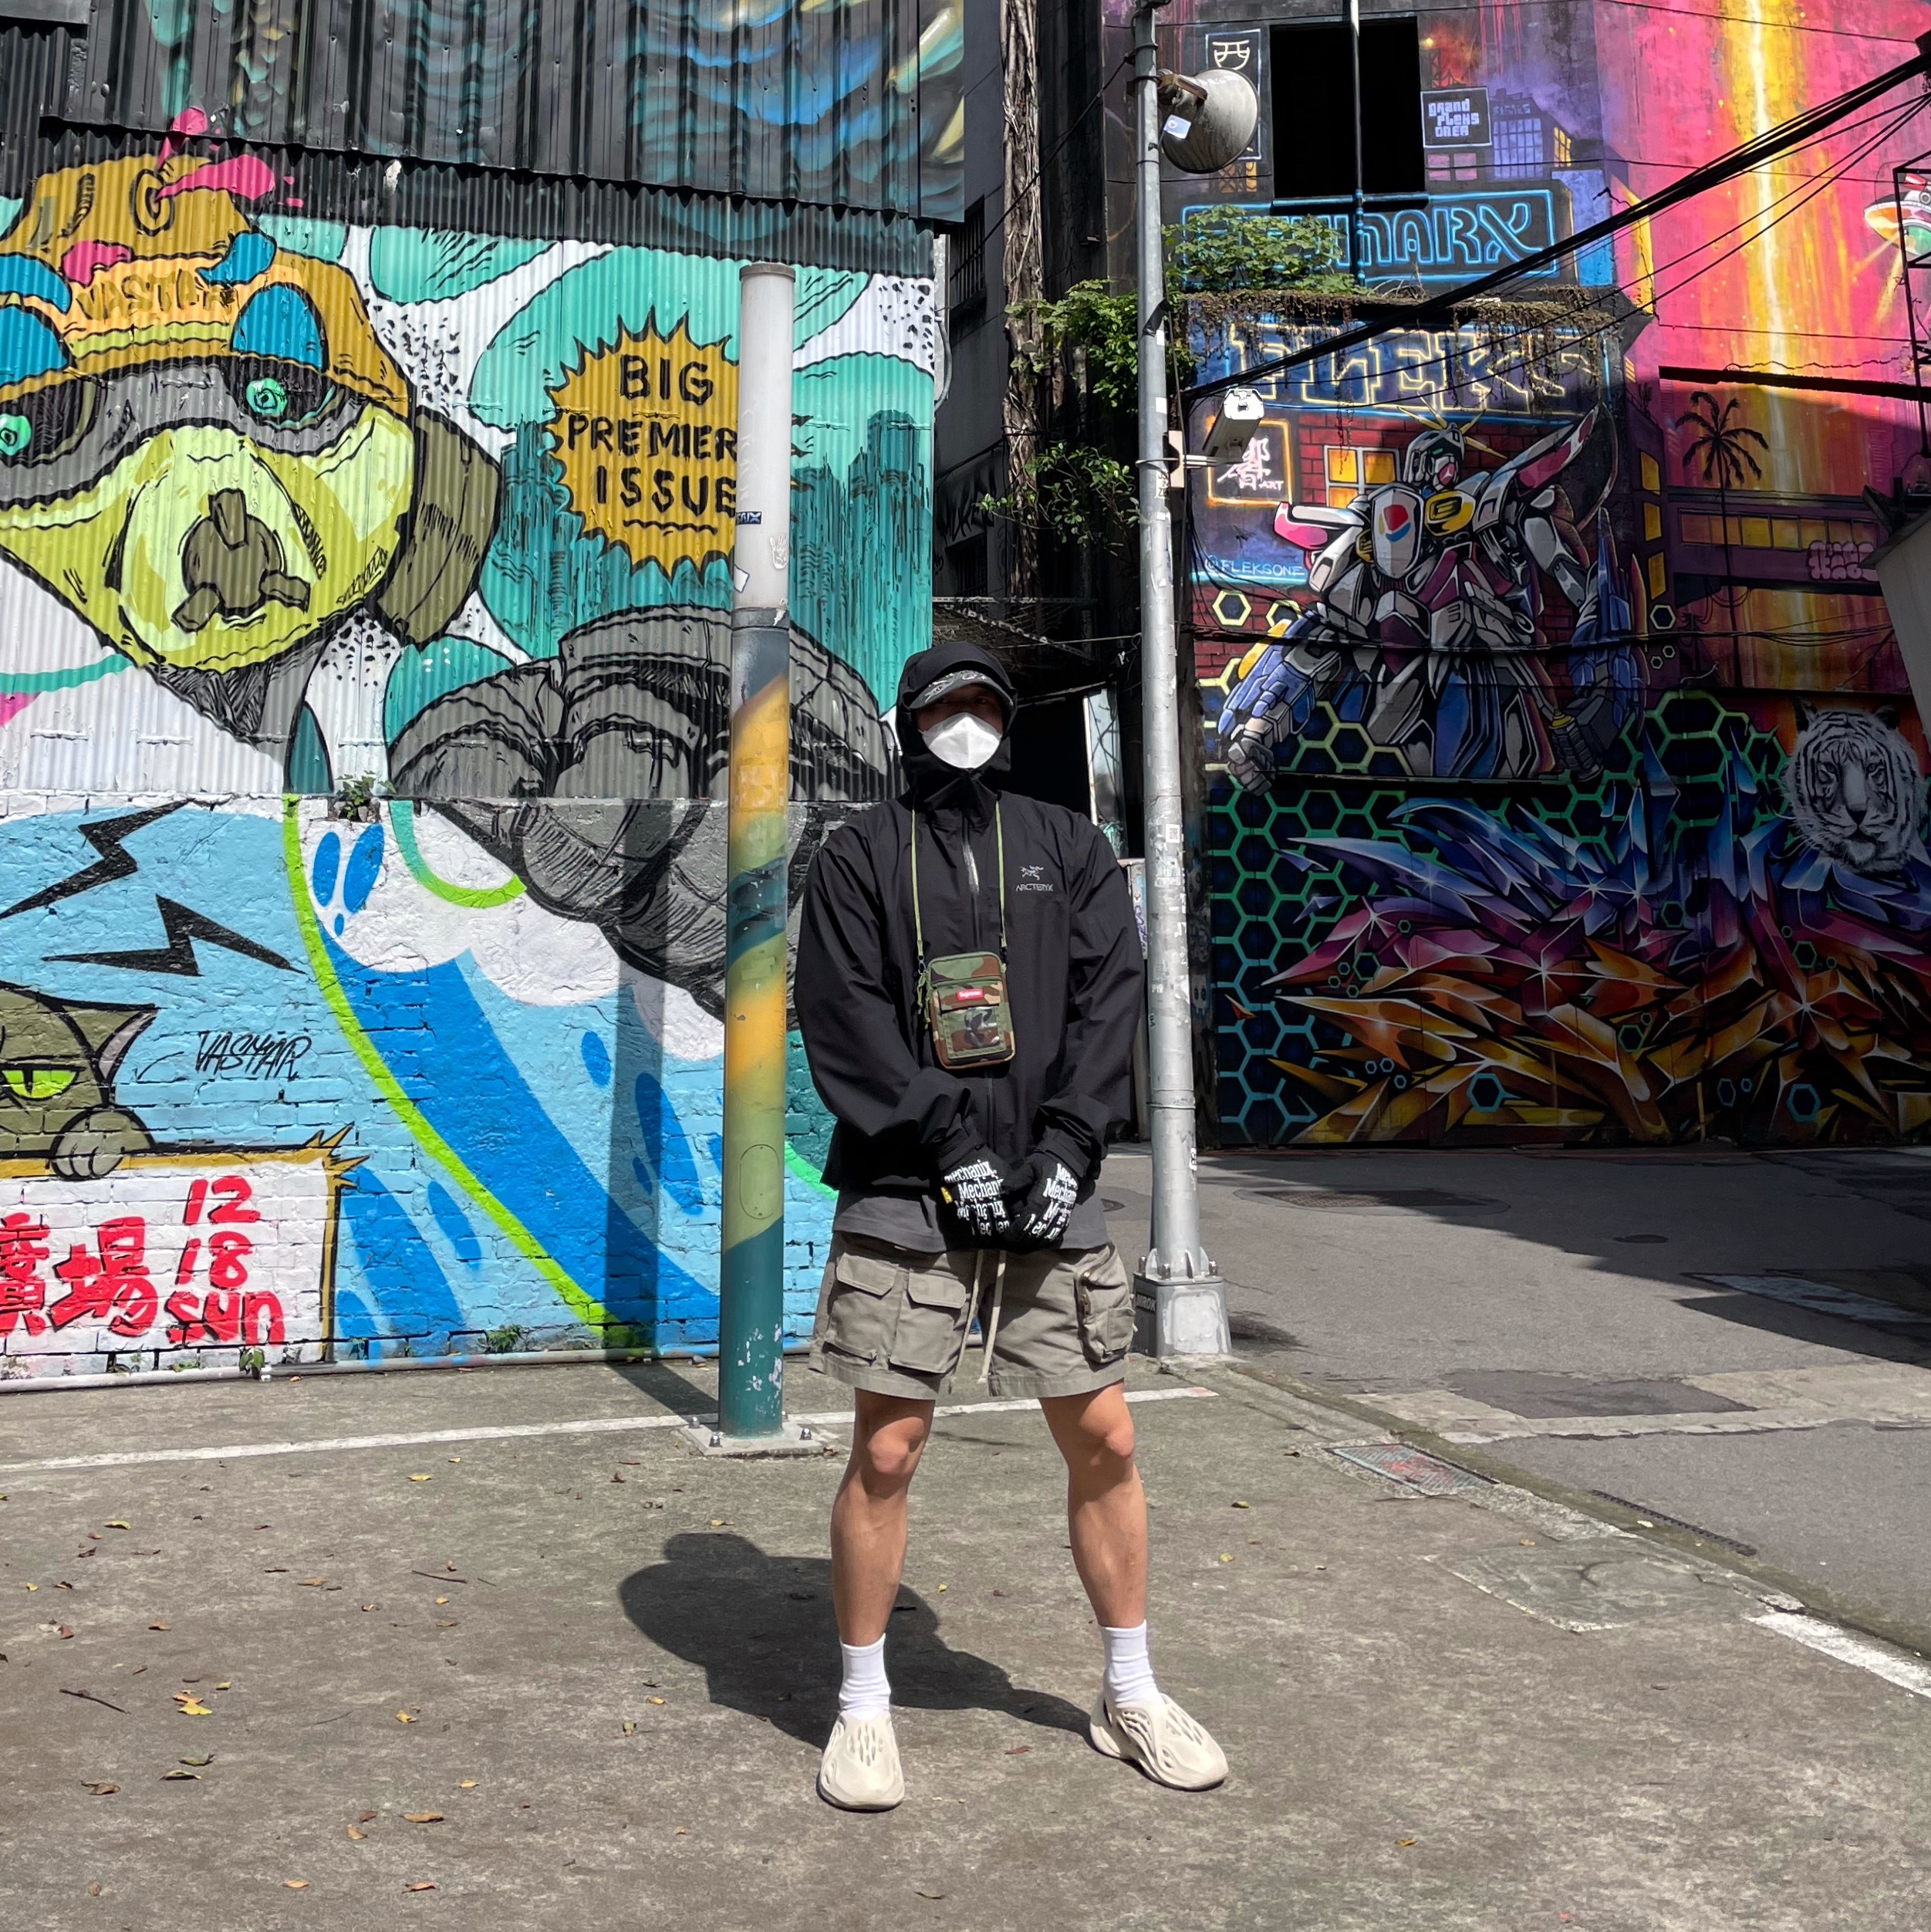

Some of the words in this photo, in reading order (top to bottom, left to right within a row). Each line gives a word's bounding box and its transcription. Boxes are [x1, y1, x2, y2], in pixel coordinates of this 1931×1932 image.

[619, 353, 714, 406] BIG
[567, 414, 738, 462] PREMIER
[596, 464, 737, 518] ISSUE
[183, 1175, 262, 1225] 12
[174, 1231, 256, 1290] 18
